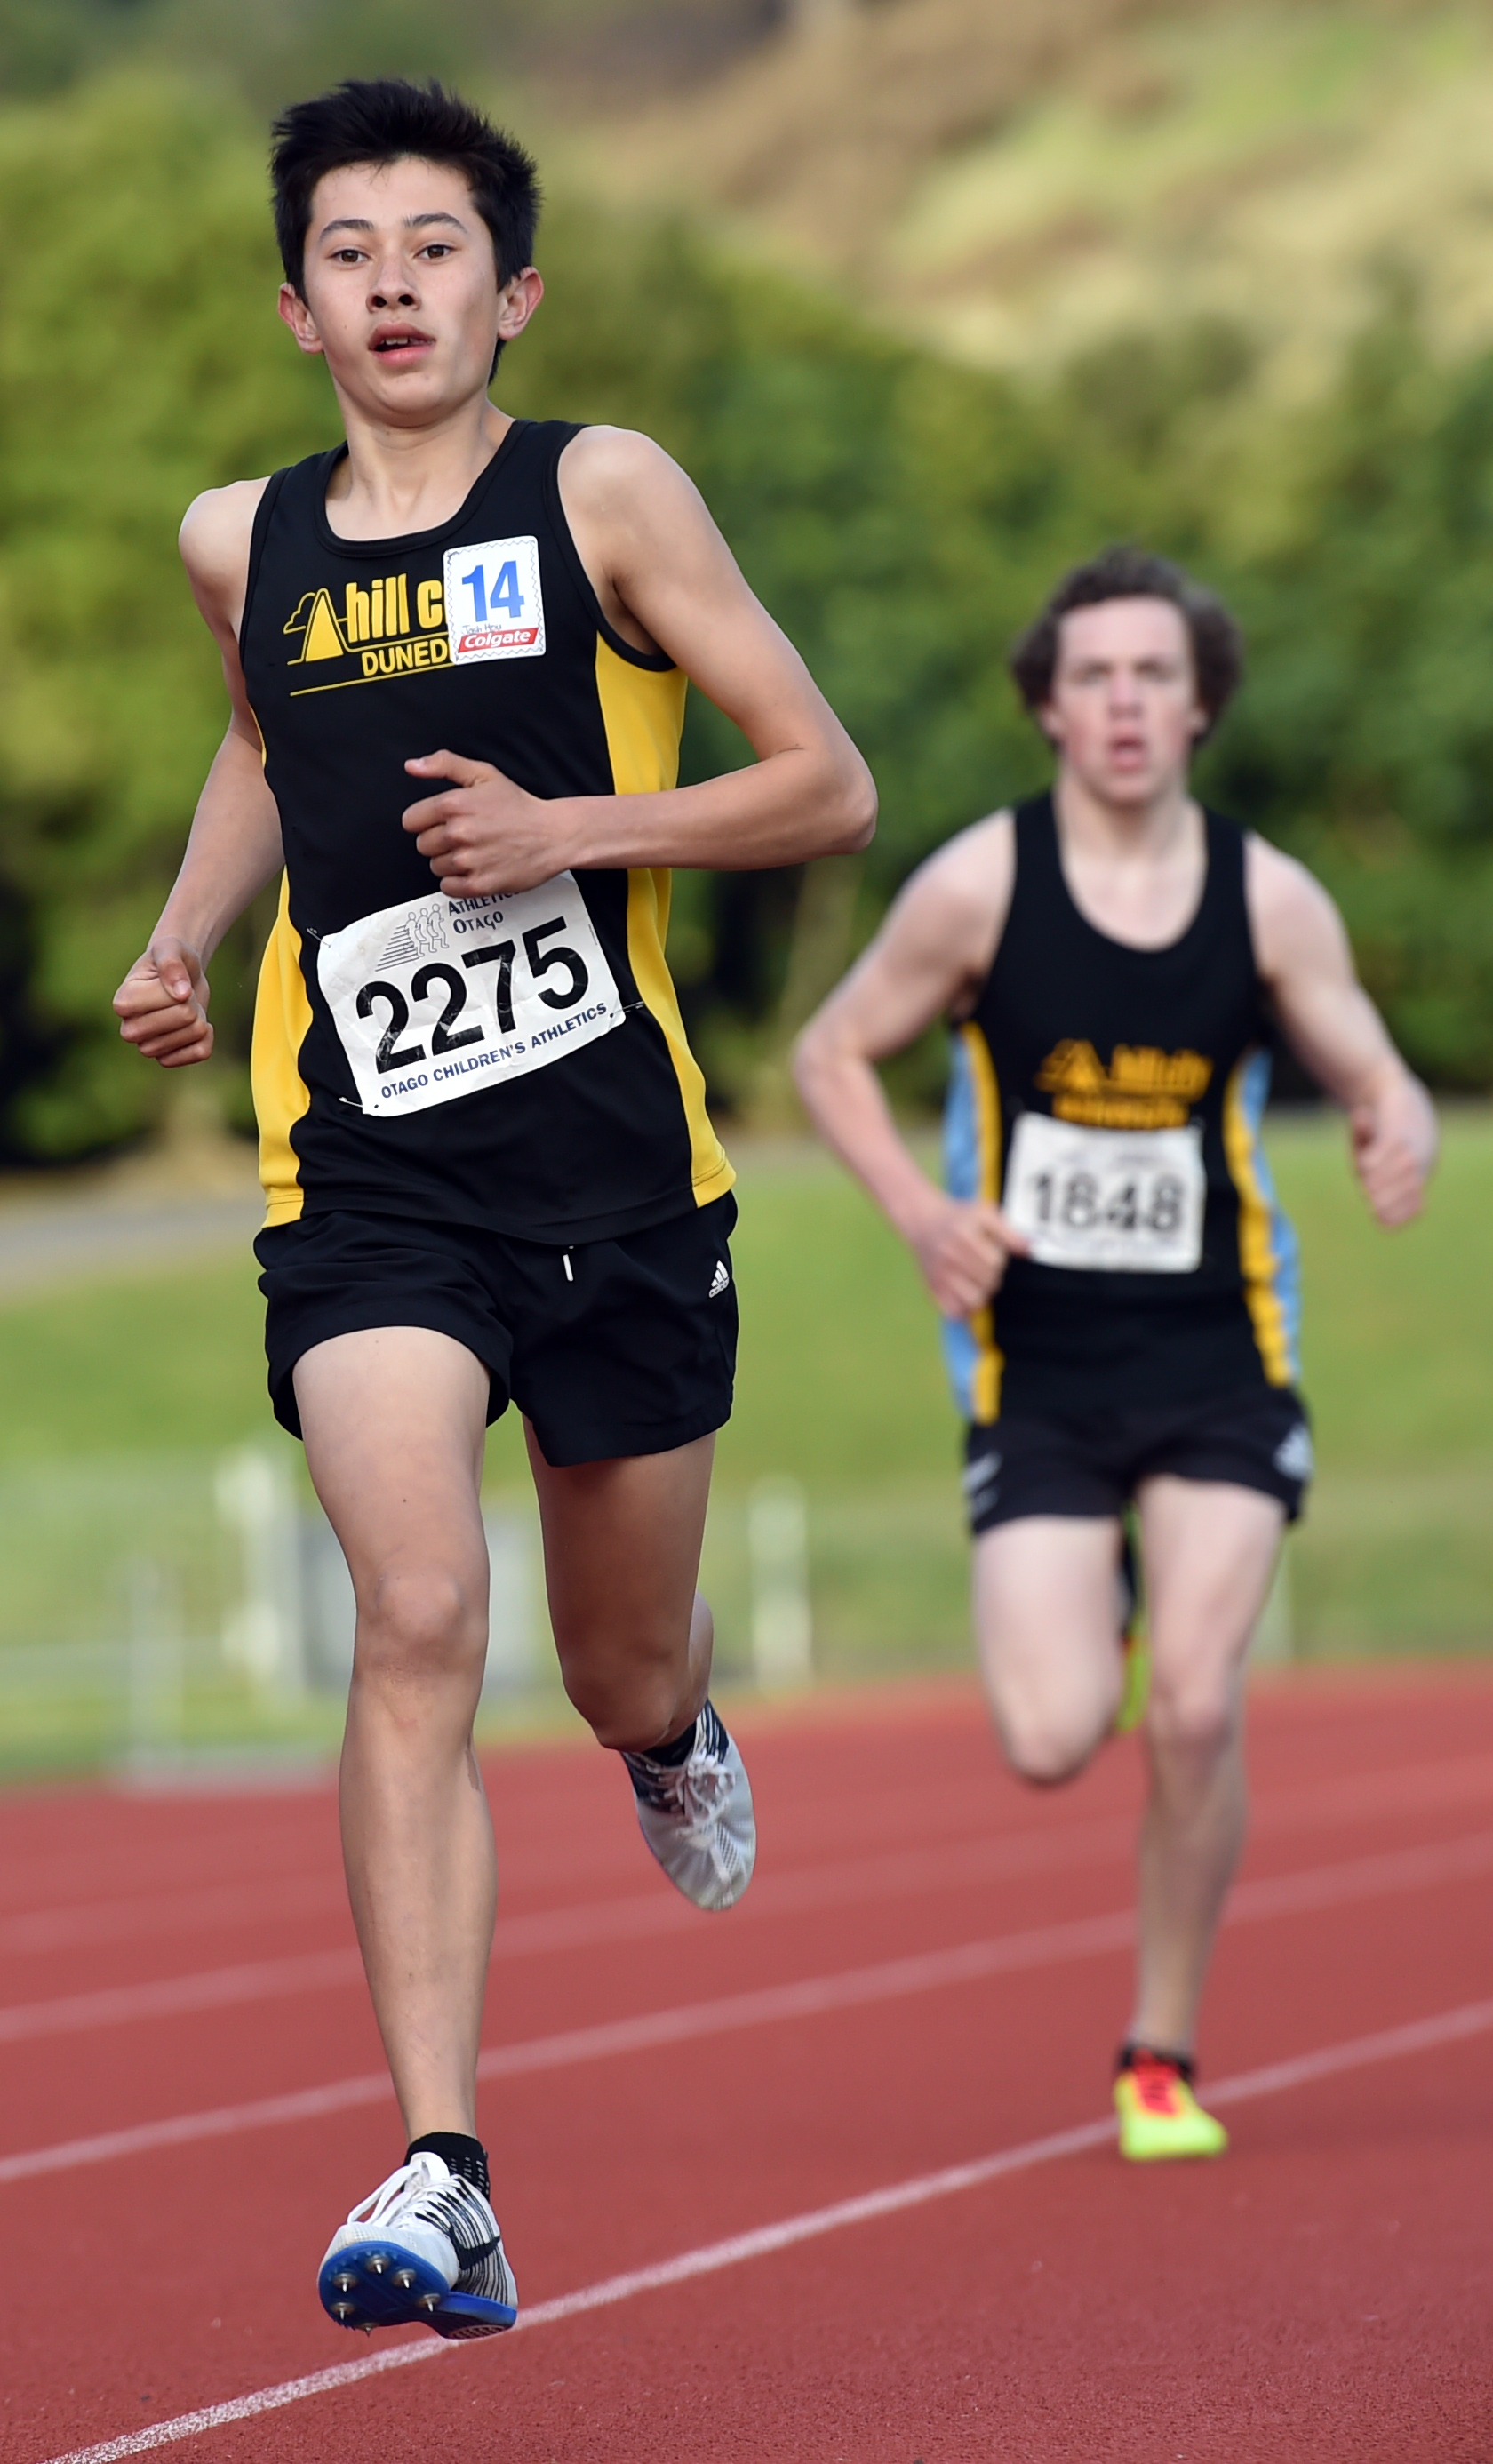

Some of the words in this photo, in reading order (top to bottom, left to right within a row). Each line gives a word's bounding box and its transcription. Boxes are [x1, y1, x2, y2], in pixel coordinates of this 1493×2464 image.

[345, 573, 410, 644] hill
[461, 559, 525, 623] 14
[361, 638, 449, 676] DUNED
[464, 630, 531, 649] Colgate
[452, 910, 504, 934] OTAGO
[355, 916, 589, 1075] 2275
[380, 1074, 429, 1100] OTAGO
[432, 1041, 526, 1082] CHILDREN'S
[531, 1002, 608, 1049] ATHLETICS
[1032, 1172, 1184, 1234] 1848
